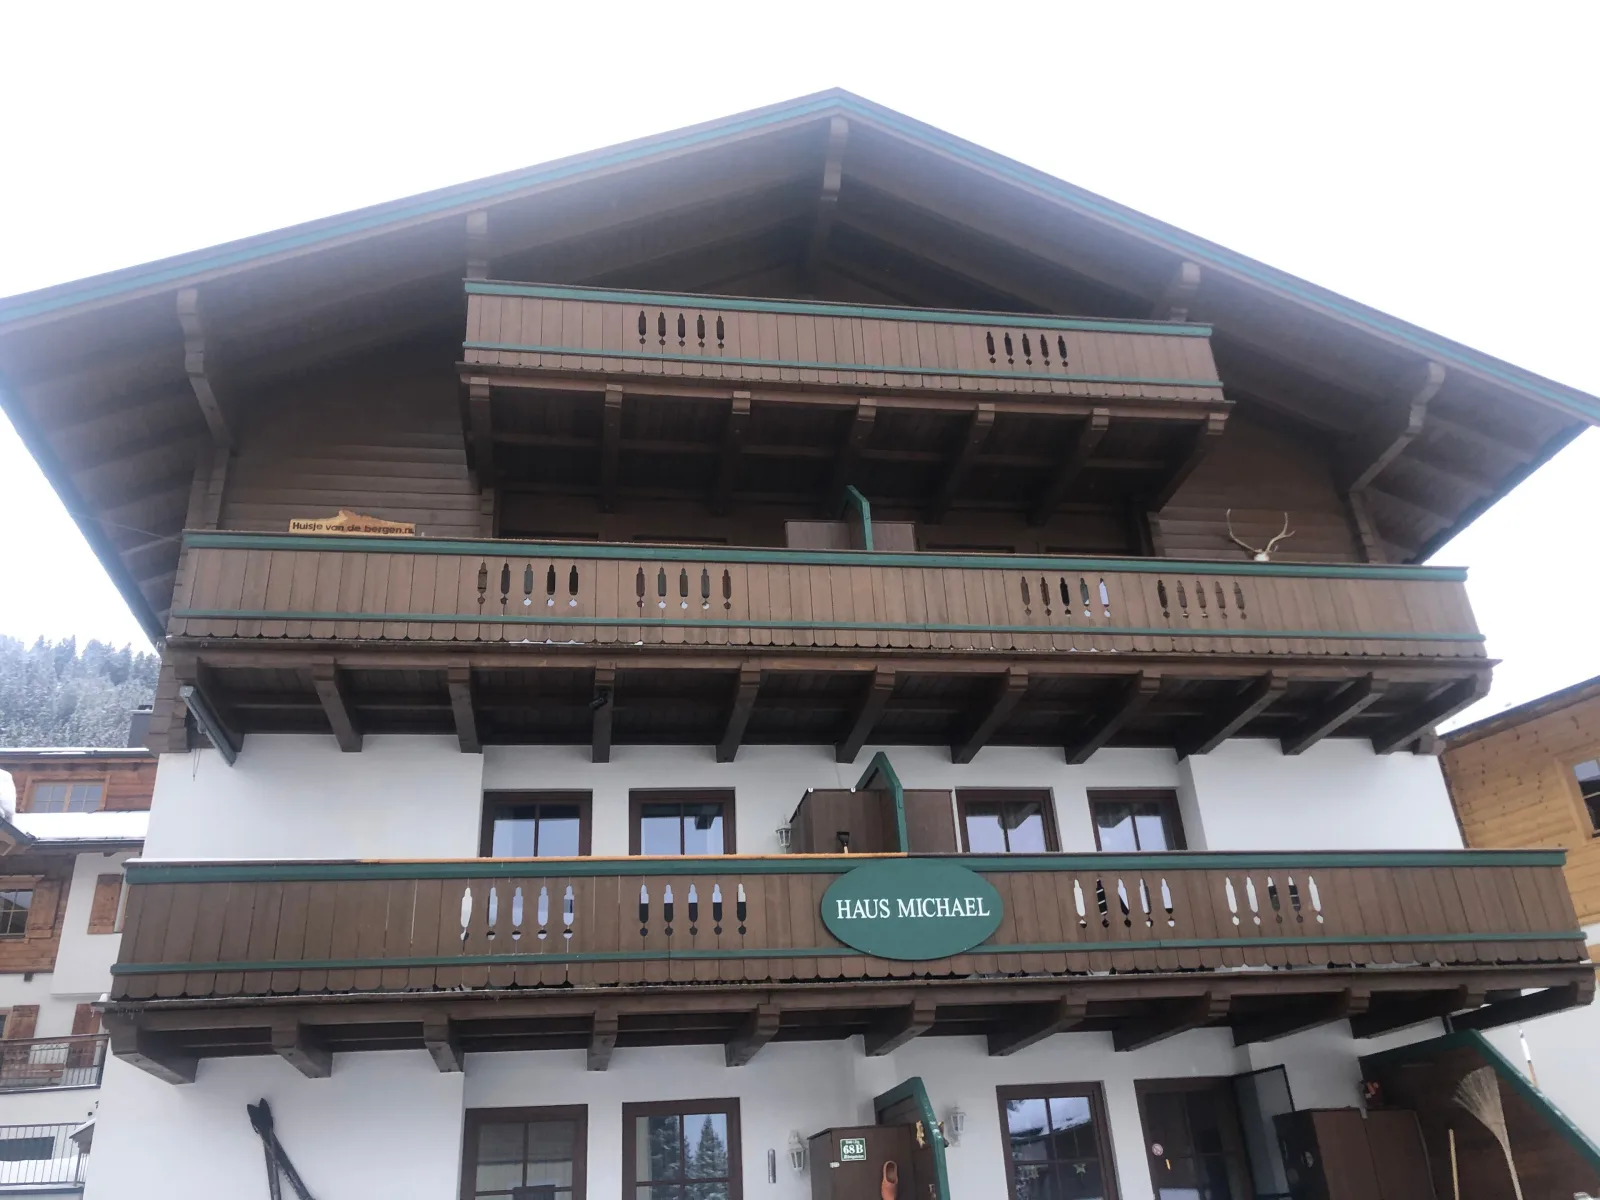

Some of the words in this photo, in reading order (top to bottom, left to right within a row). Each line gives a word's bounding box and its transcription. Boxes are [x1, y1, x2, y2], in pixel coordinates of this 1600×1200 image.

[292, 521, 323, 532] Huisje
[347, 524, 361, 532] de
[836, 899, 890, 919] HAUS
[897, 897, 990, 918] MICHAEL
